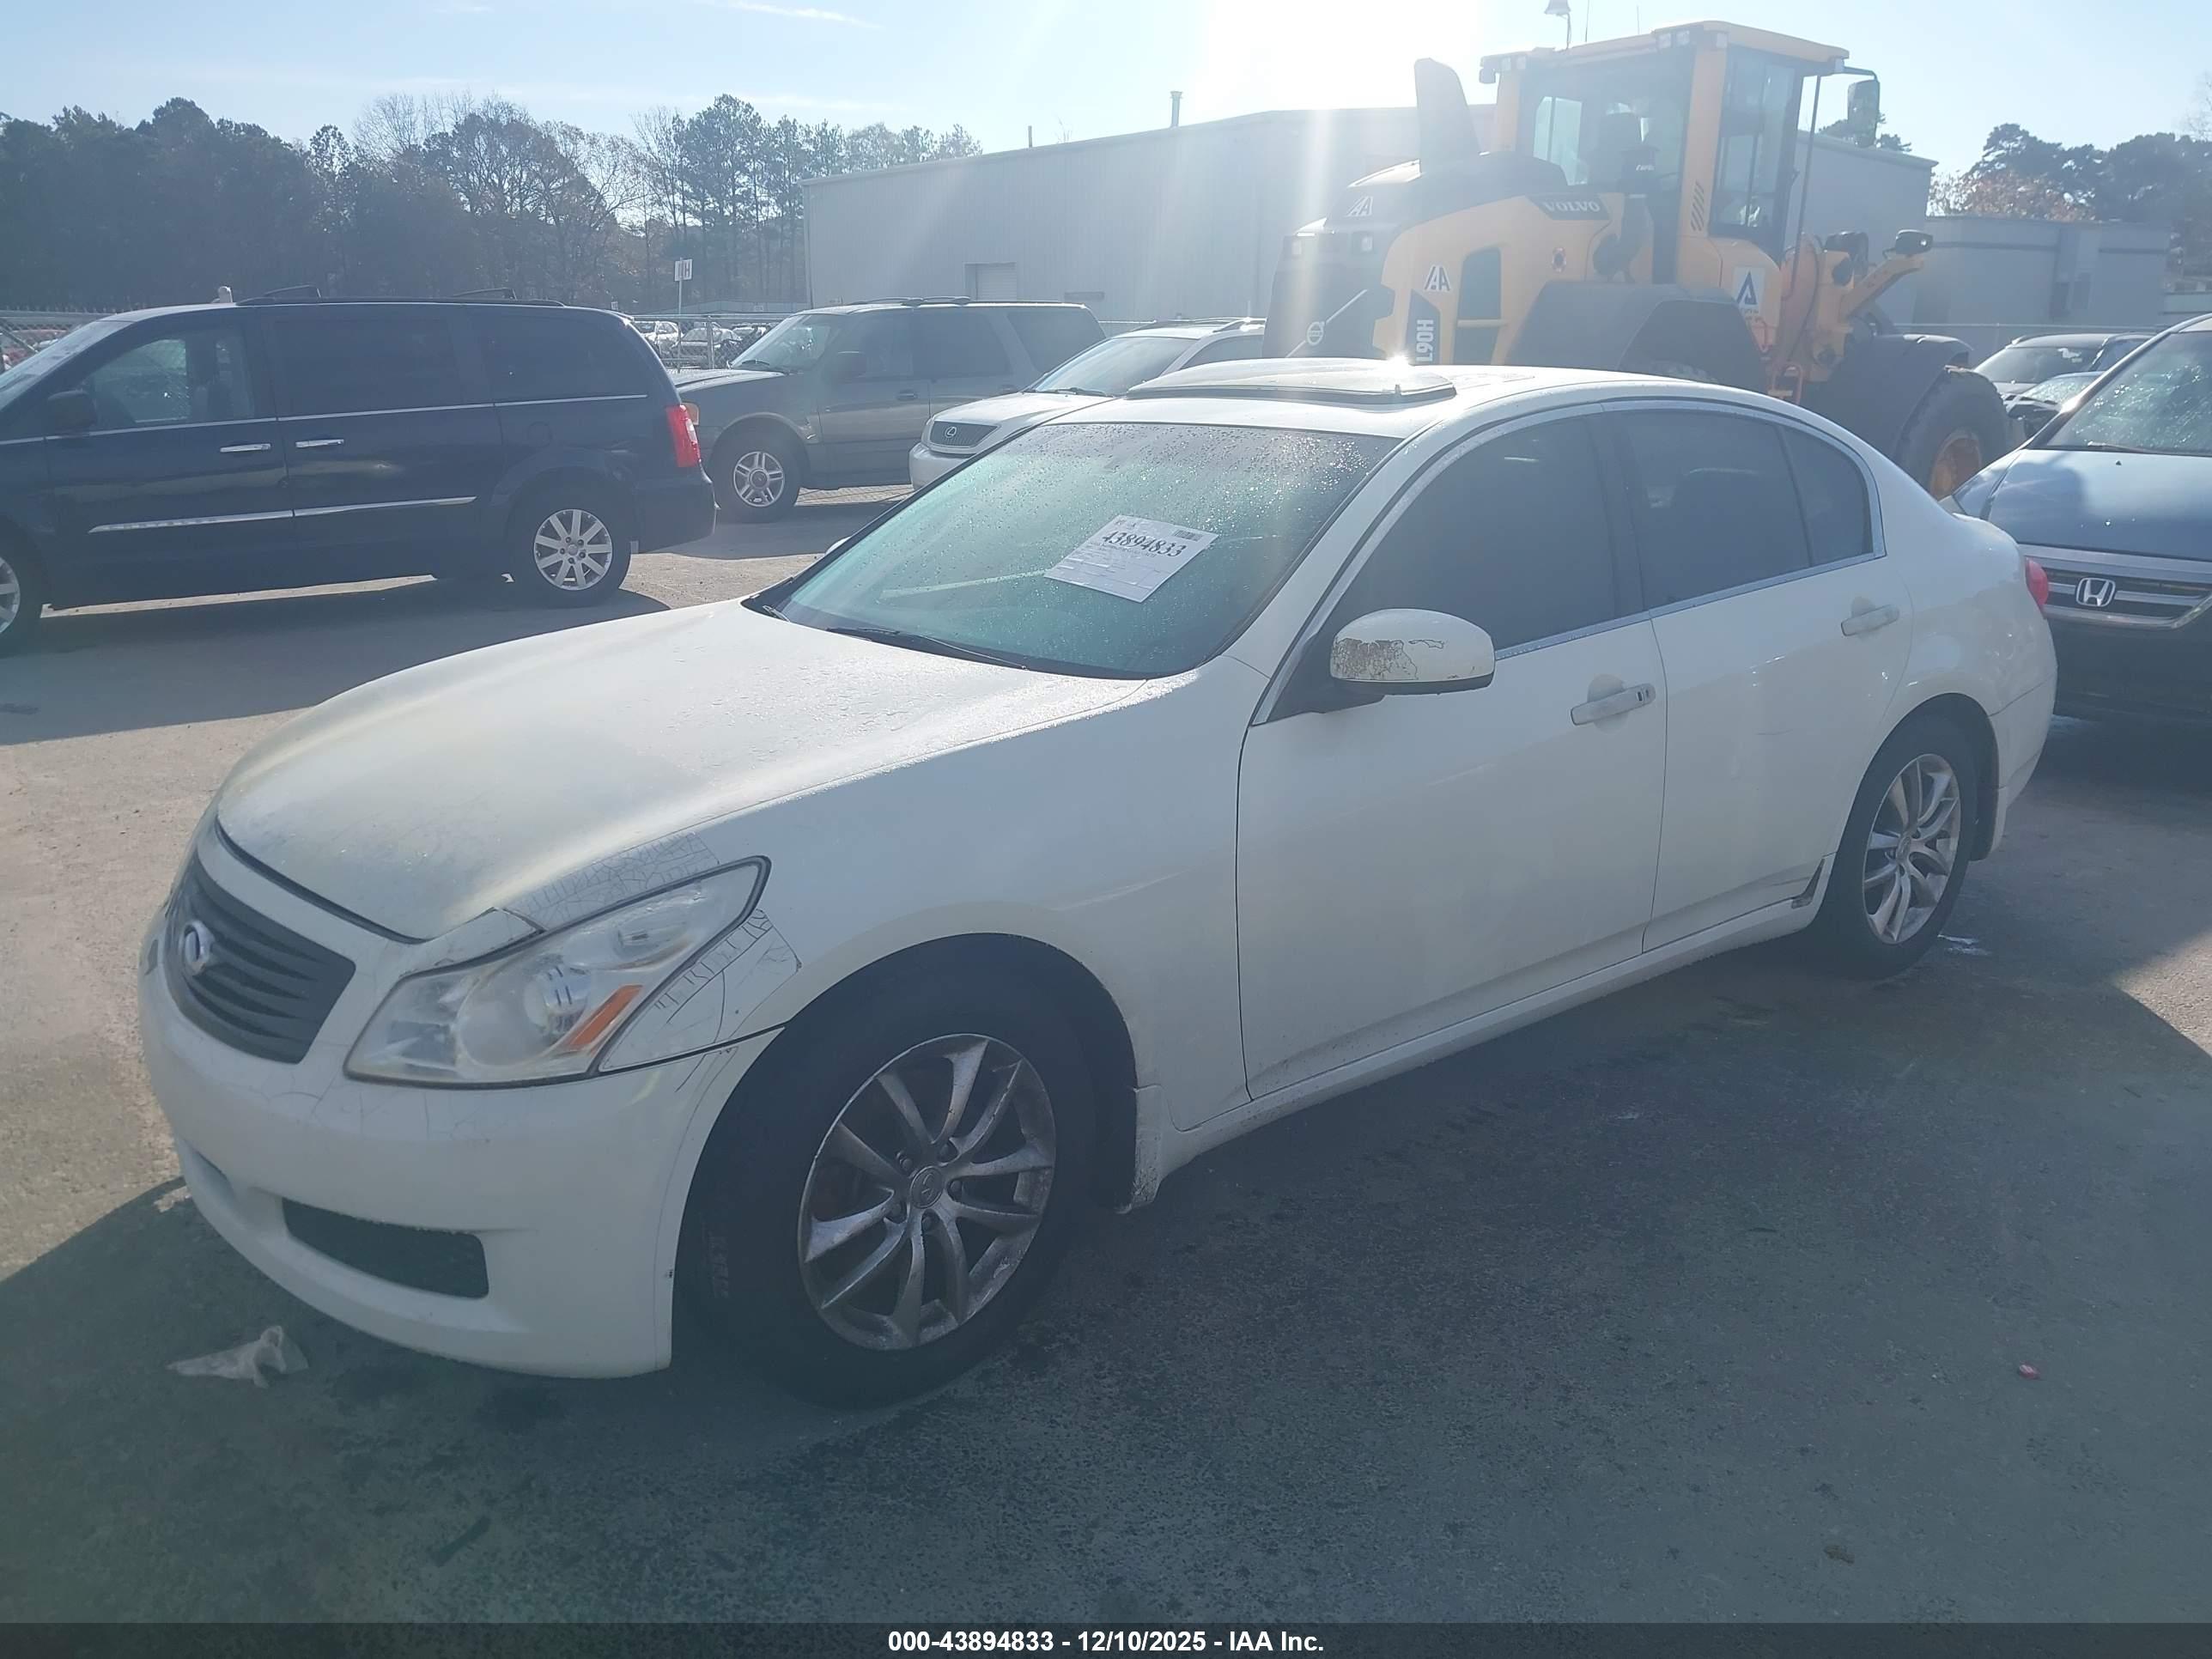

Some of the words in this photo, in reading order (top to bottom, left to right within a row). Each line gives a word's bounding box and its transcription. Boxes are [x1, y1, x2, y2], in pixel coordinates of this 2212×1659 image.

[1543, 200, 1600, 212] VOLVO
[1416, 319, 1434, 362] L90H
[1103, 531, 1187, 557] 43894833
